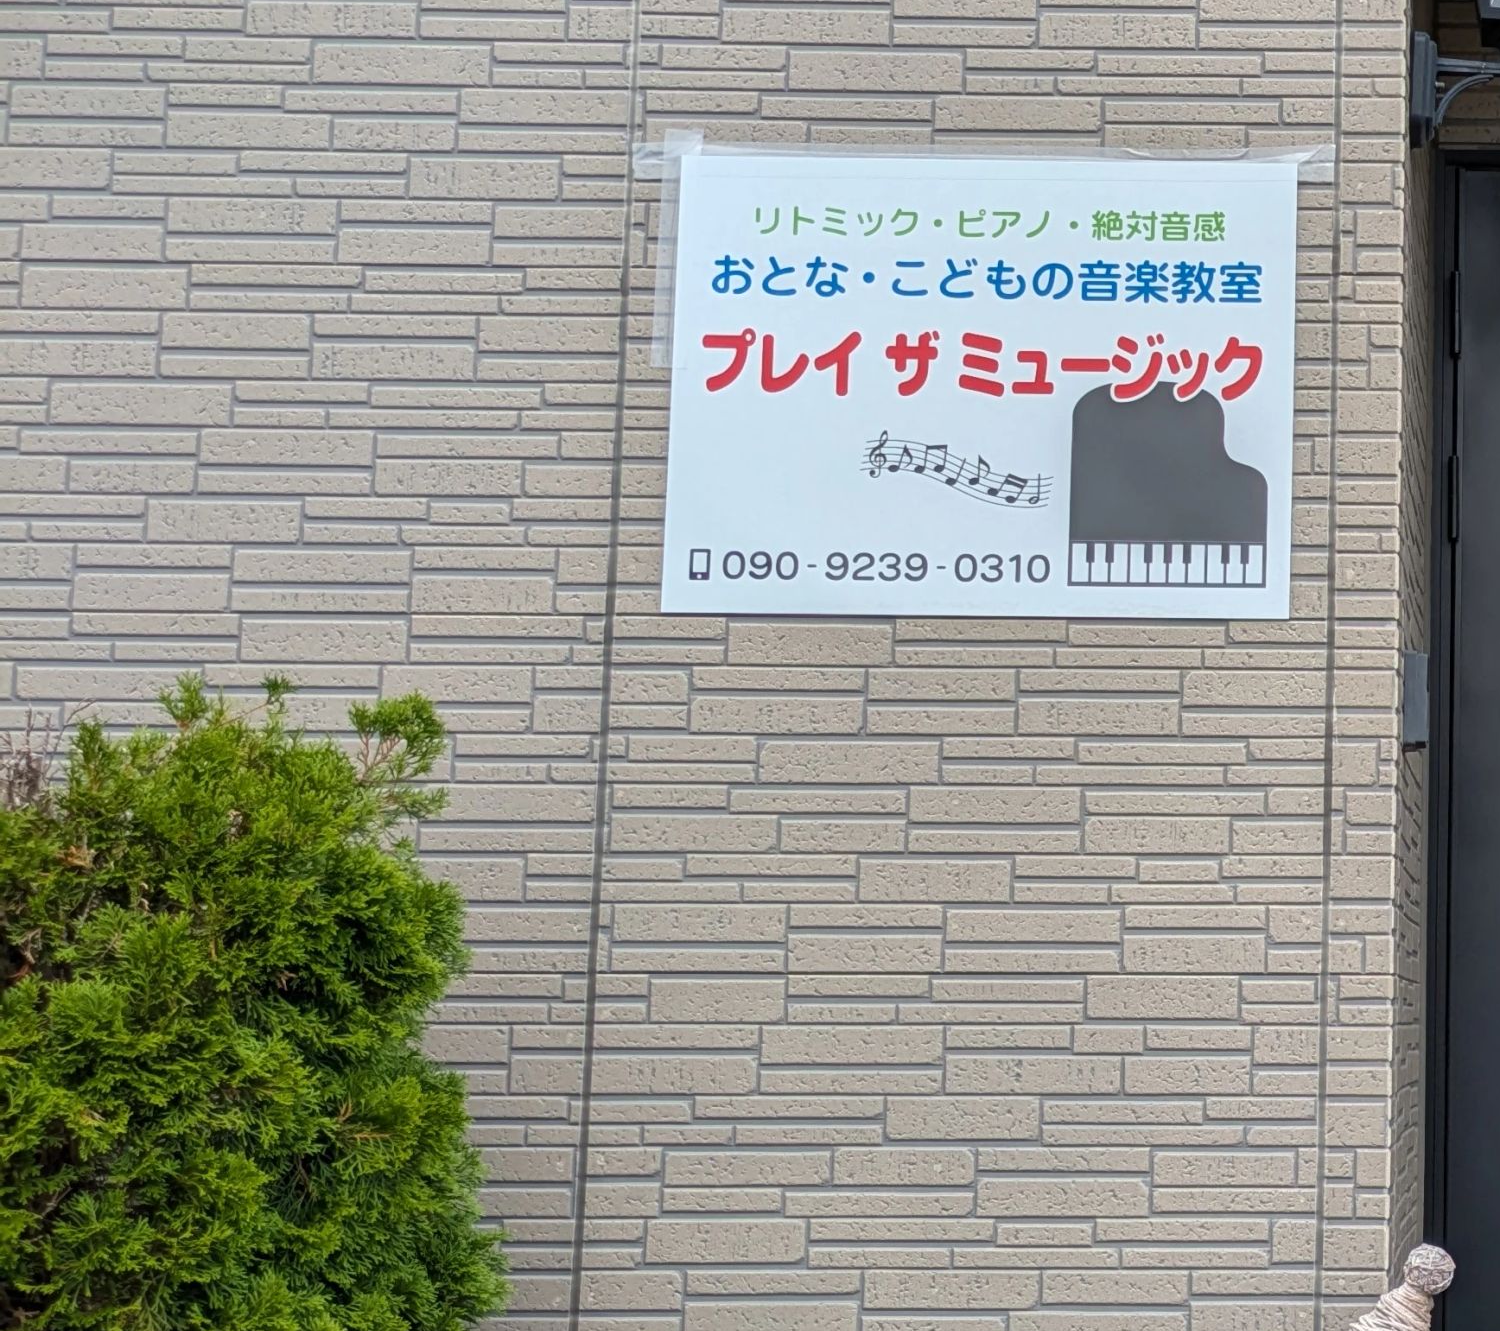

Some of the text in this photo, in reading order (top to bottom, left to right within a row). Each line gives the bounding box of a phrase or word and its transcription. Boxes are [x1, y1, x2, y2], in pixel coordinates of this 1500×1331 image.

[754, 205, 1226, 242] リトミック・ピアノ・絶対音感
[710, 253, 1264, 305] おとな・こどもの音楽教室
[702, 328, 1264, 401] プレイ ザ ミュージック
[721, 549, 1051, 584] 090-9239-0310
